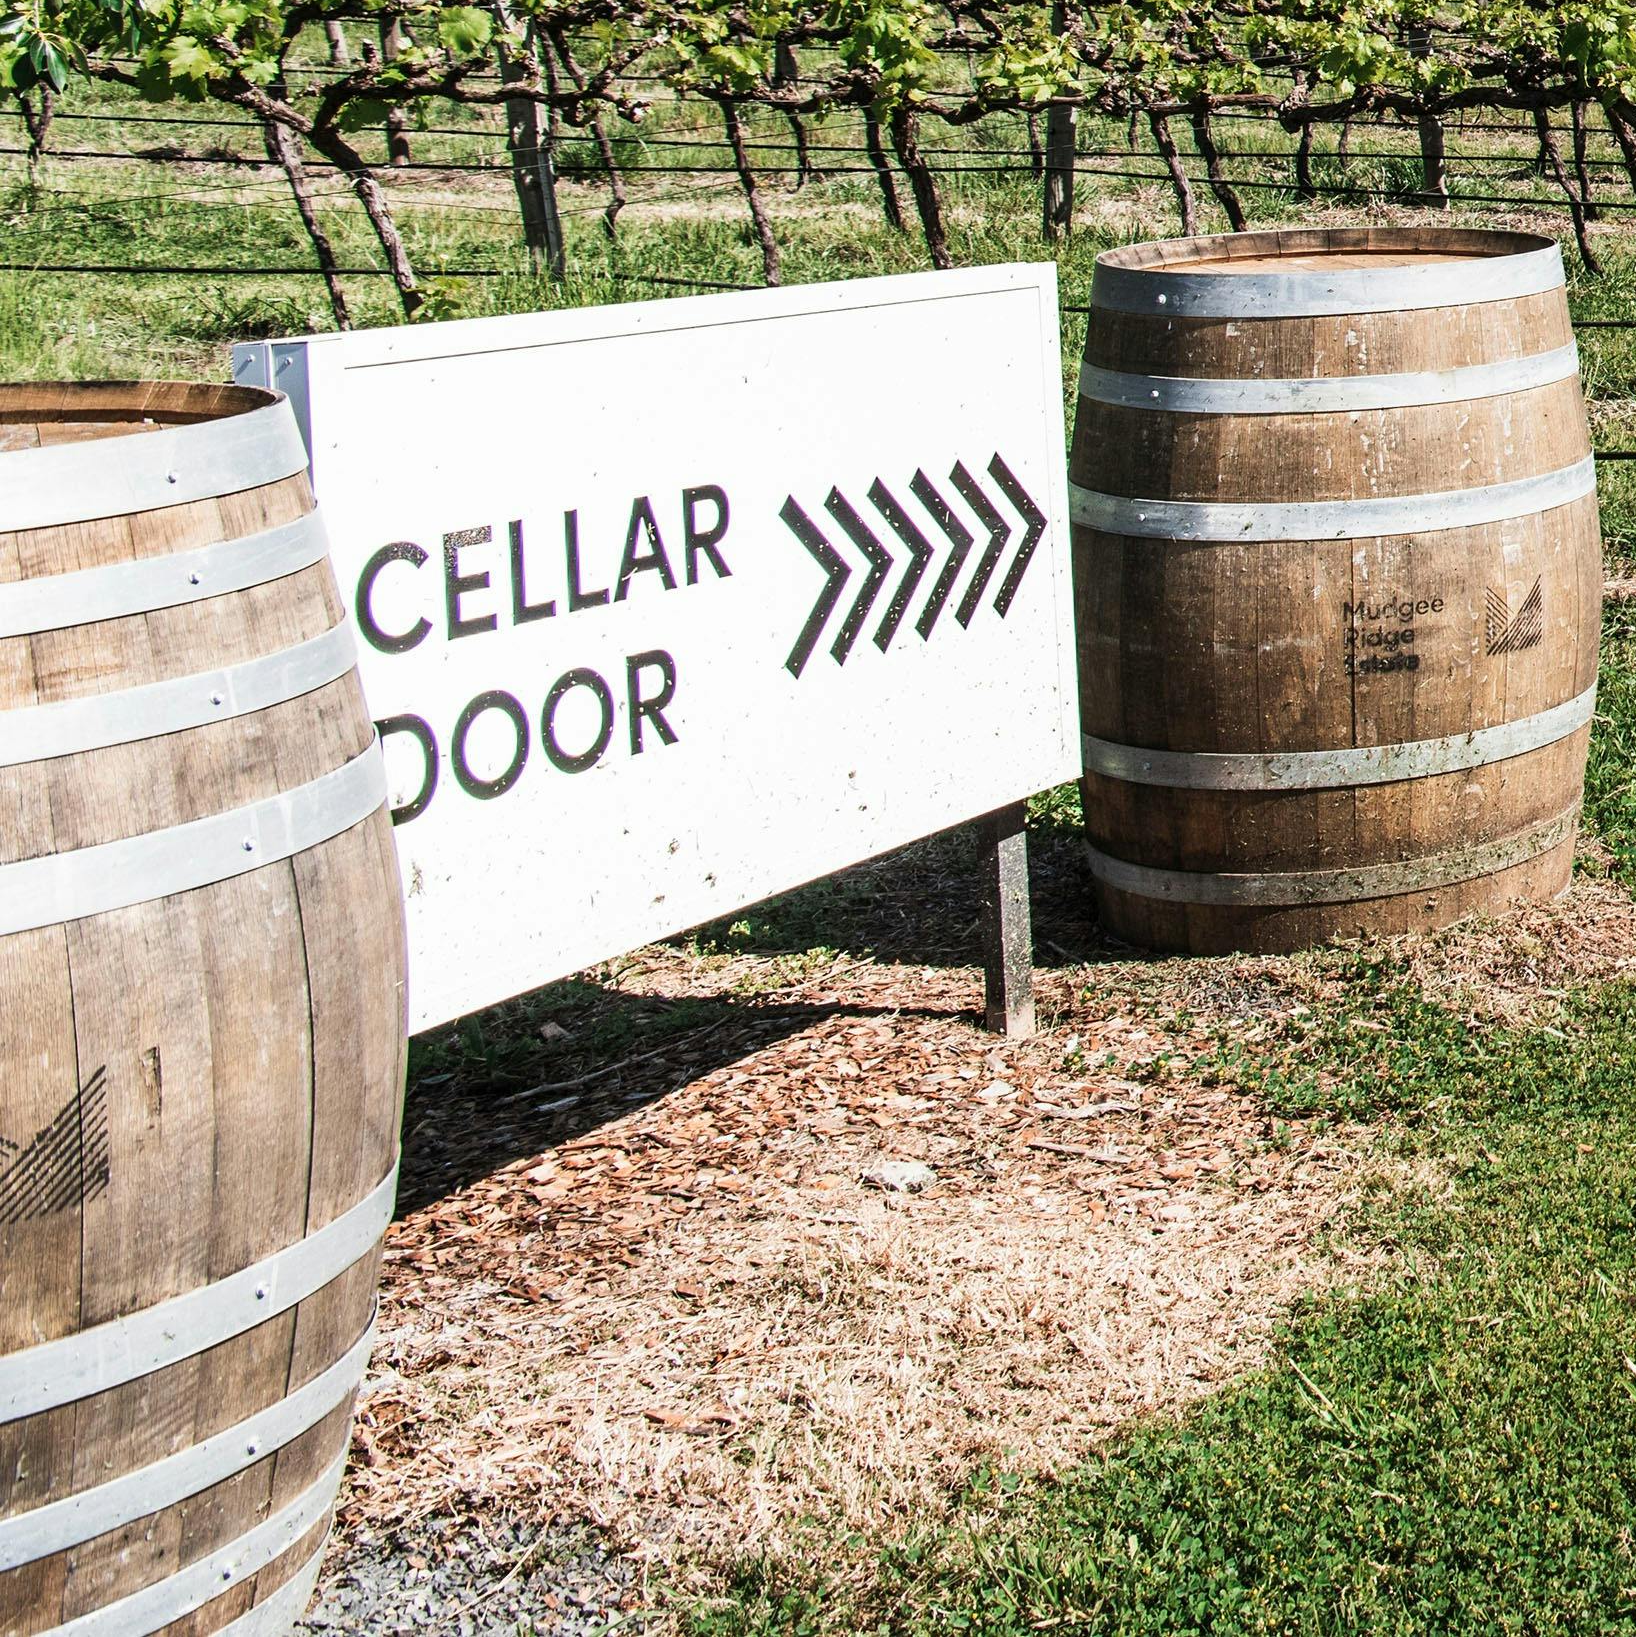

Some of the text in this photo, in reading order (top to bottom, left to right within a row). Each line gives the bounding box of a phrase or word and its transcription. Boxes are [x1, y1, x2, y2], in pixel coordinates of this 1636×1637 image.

[355, 484, 733, 655] CELLAR
[1342, 596, 1444, 623] Mudgee
[1344, 625, 1415, 652] Ridge
[373, 649, 679, 827] DOOR
